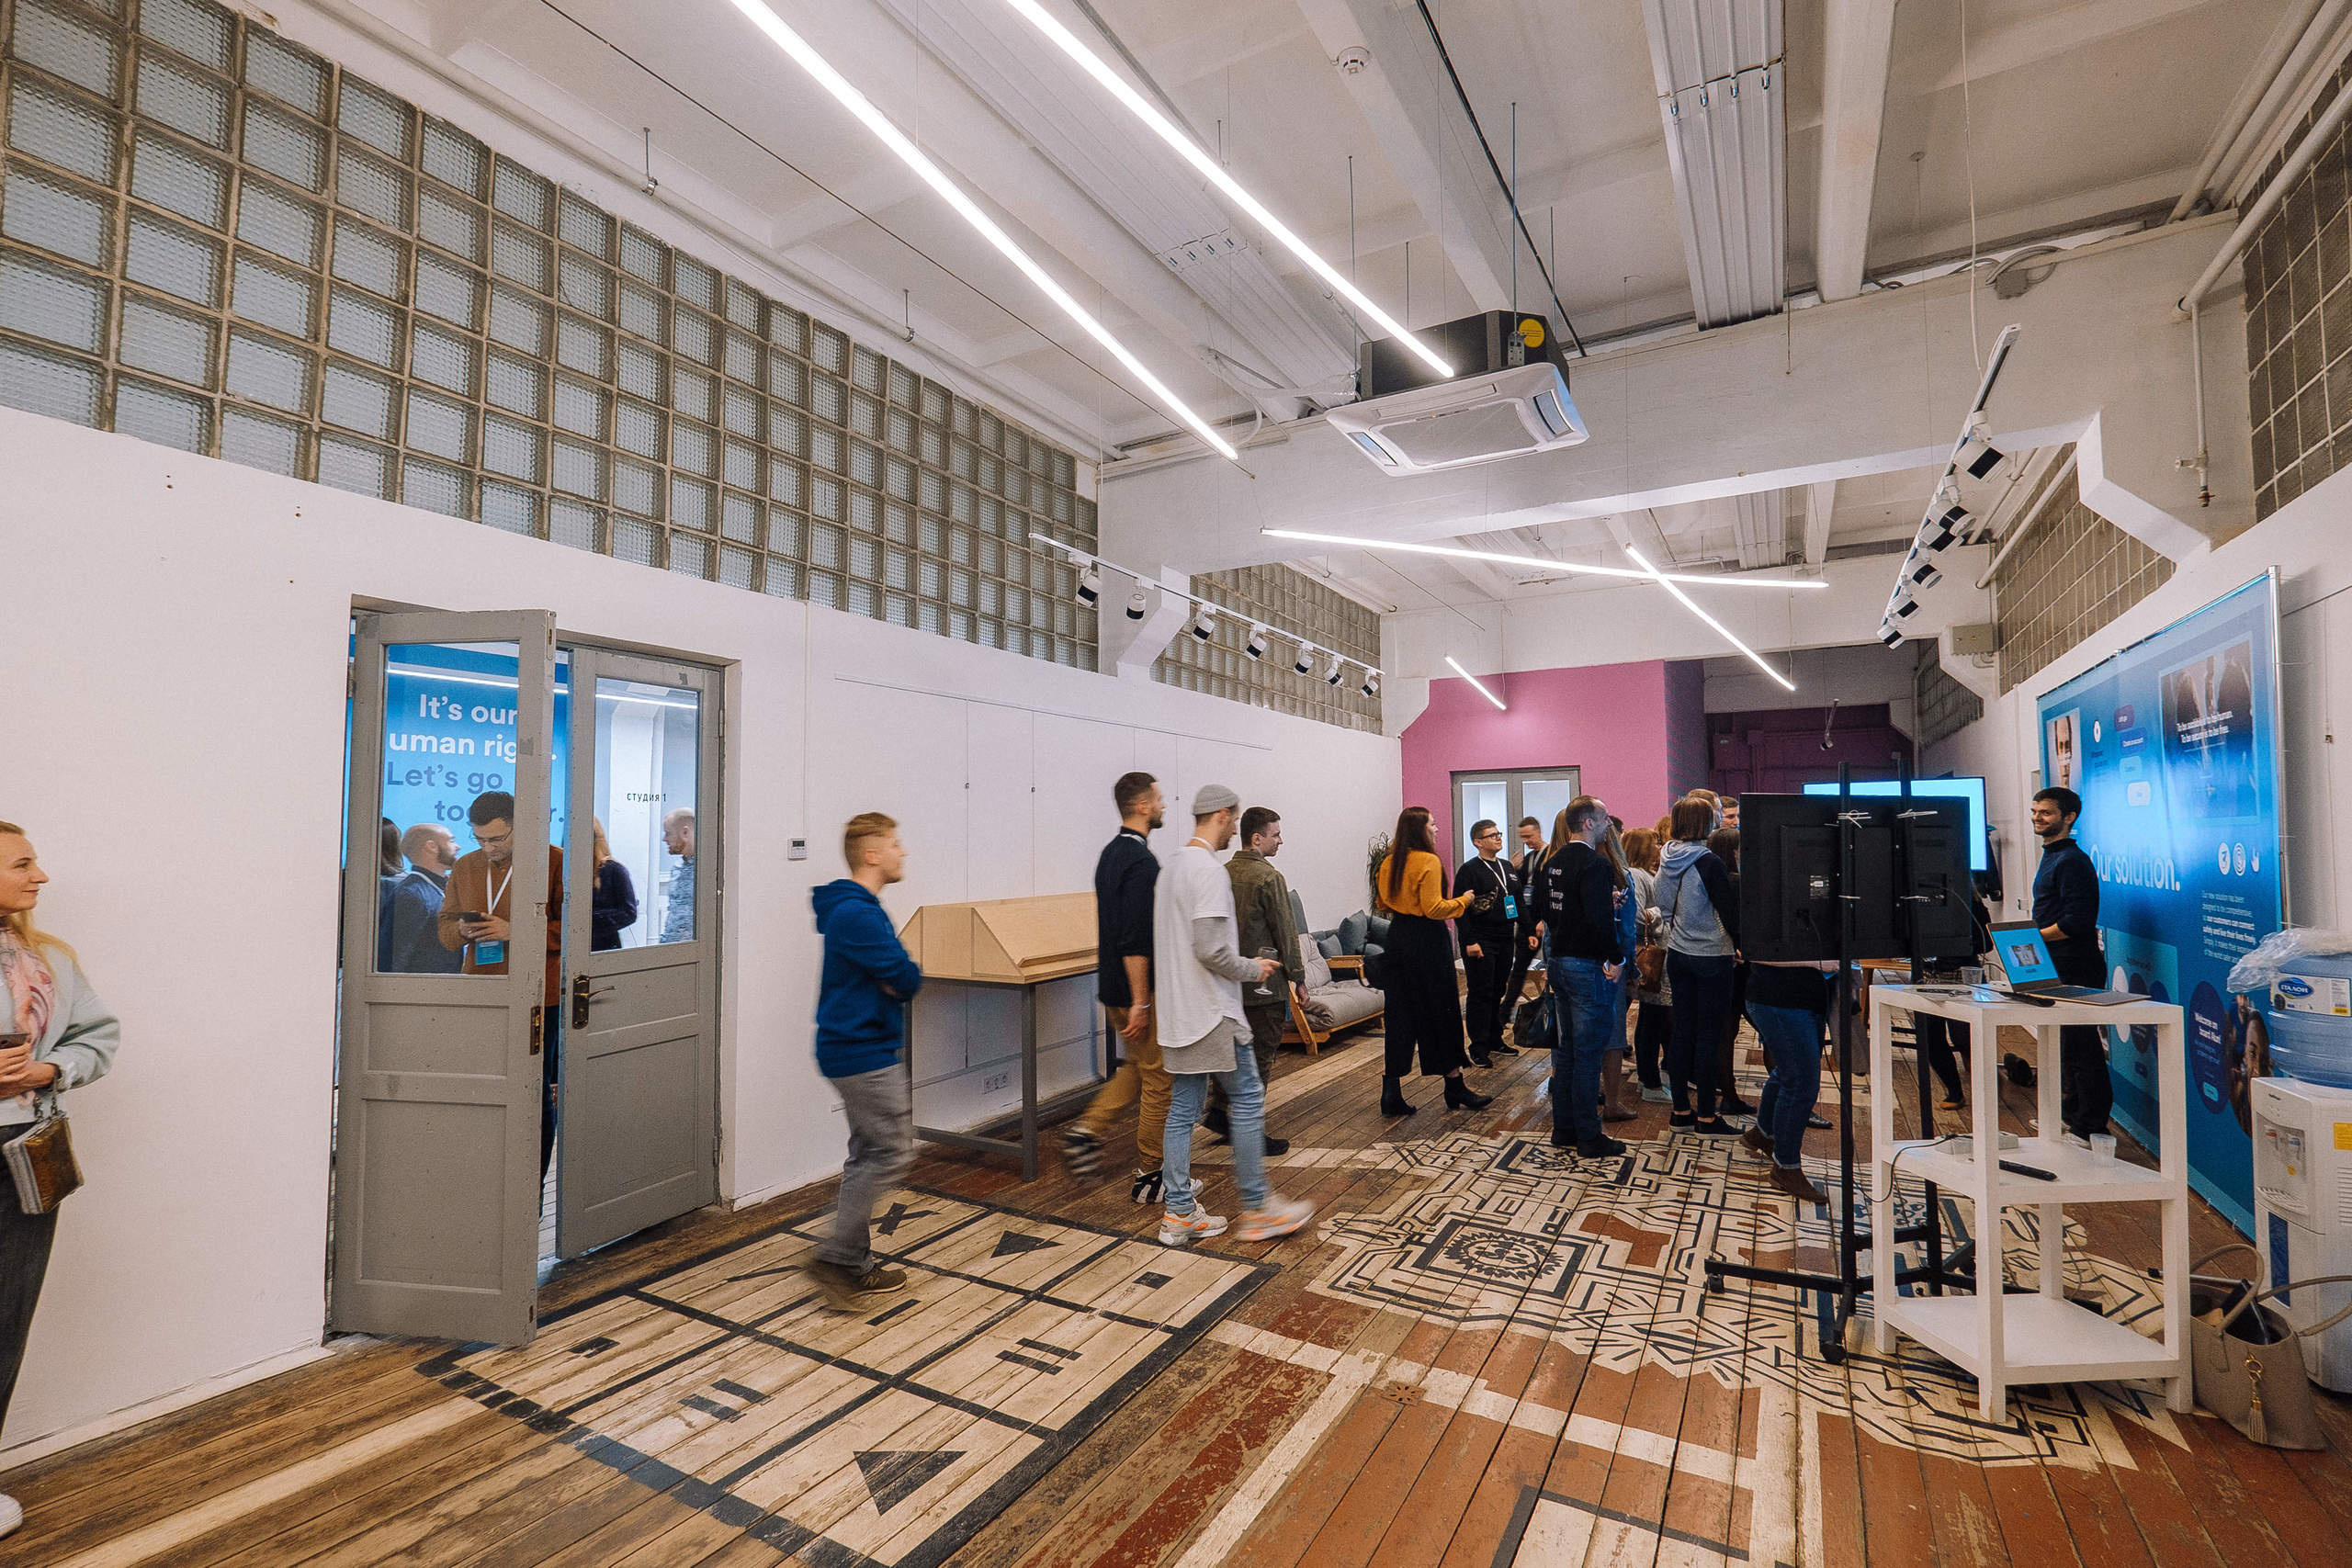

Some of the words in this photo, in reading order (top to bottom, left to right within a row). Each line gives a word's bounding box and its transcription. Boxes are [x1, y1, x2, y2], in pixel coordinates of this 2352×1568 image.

[419, 694, 463, 721] It’s
[470, 705, 517, 726] our
[390, 732, 475, 755] uman
[387, 761, 458, 788] Let’s
[467, 773, 503, 795] go
[662, 793, 667, 803] 1
[2090, 844, 2111, 882] Our
[2115, 845, 2181, 891] solution.
